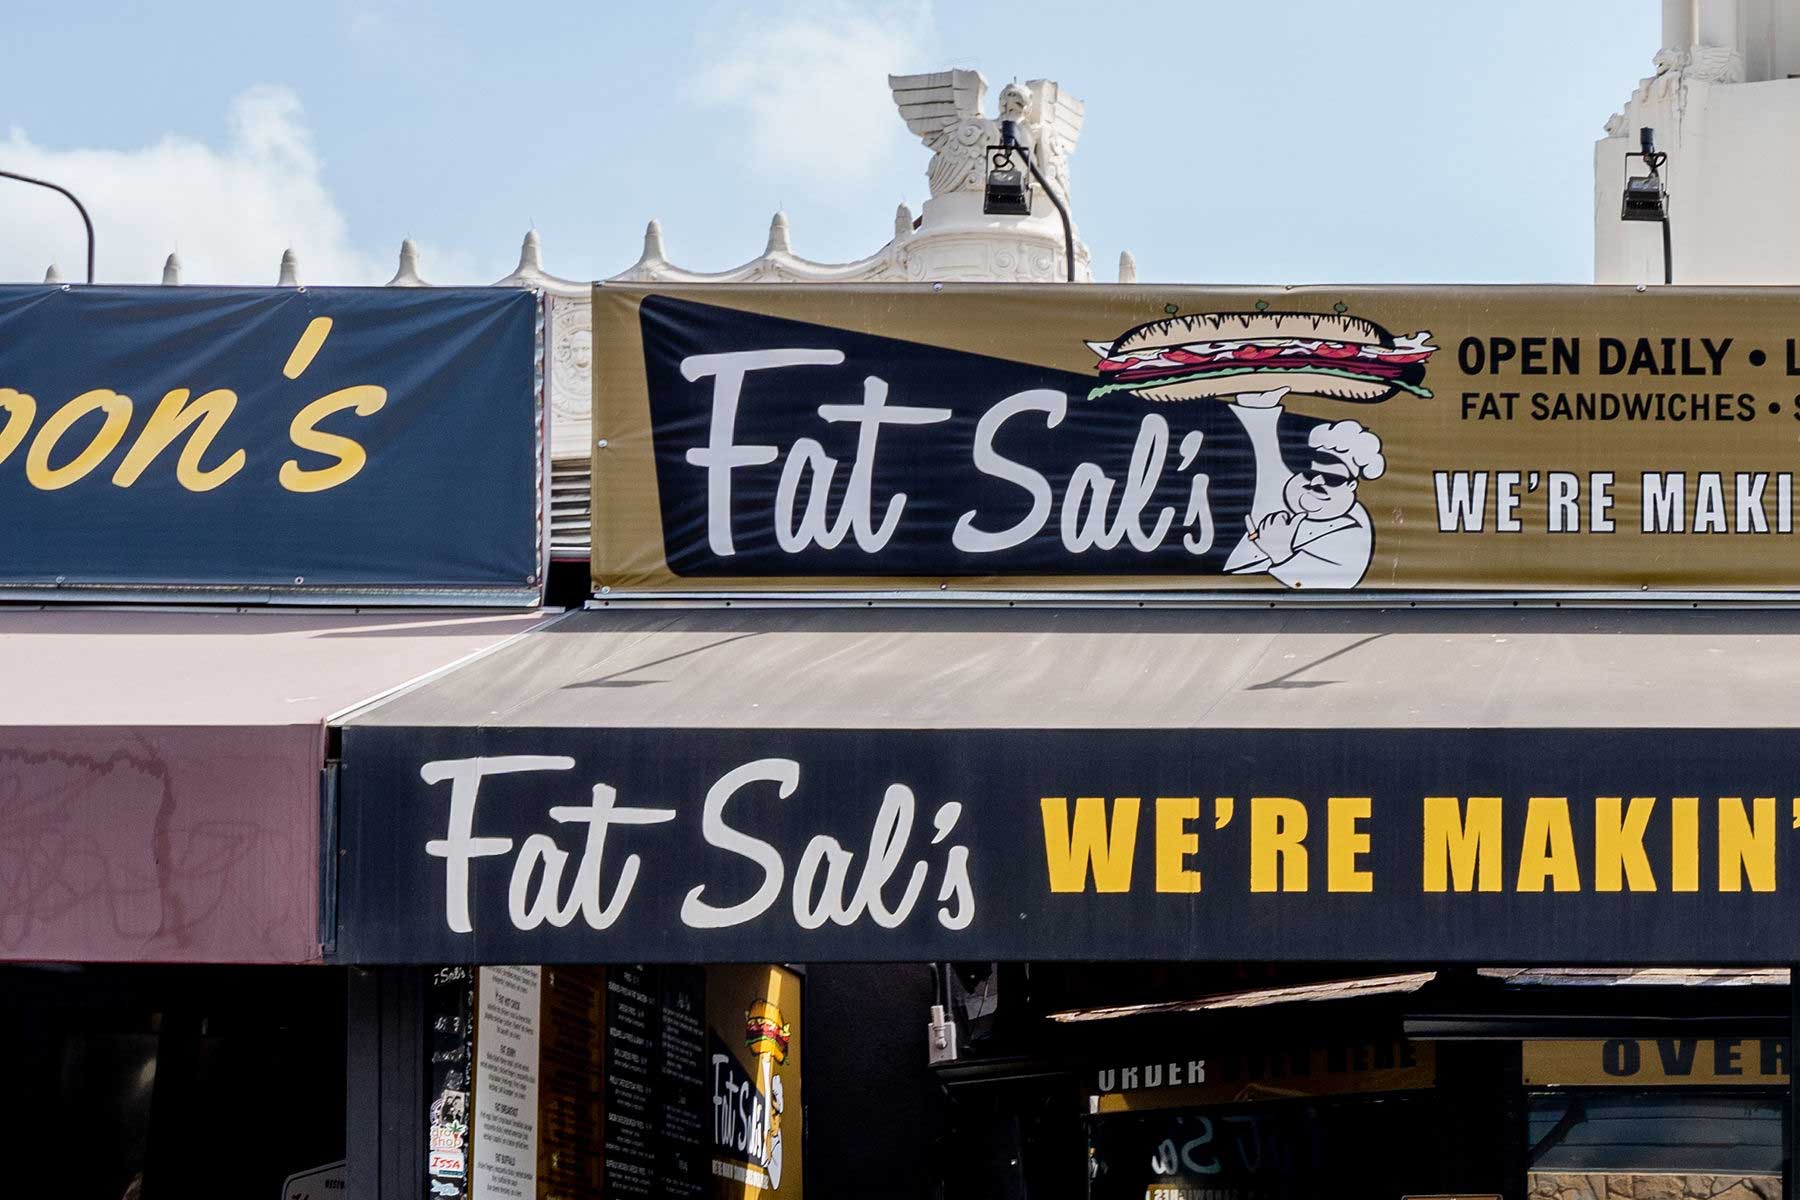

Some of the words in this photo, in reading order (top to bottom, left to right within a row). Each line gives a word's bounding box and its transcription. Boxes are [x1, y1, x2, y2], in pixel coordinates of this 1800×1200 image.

[1458, 337, 1580, 376] OPEN
[1600, 337, 1733, 377] DAILY
[1461, 392, 1516, 421] FAT
[1531, 392, 1756, 422] SANDWICHES
[681, 348, 951, 555] Fat
[951, 389, 1214, 554] Sal's
[1432, 470, 1616, 534] WE'RE
[420, 755, 677, 933] Fat
[679, 758, 976, 932] Sal's
[1040, 796, 1373, 894] WE'RE
[1601, 1039, 1791, 1077] OVER
[712, 1053, 739, 1145] Fat
